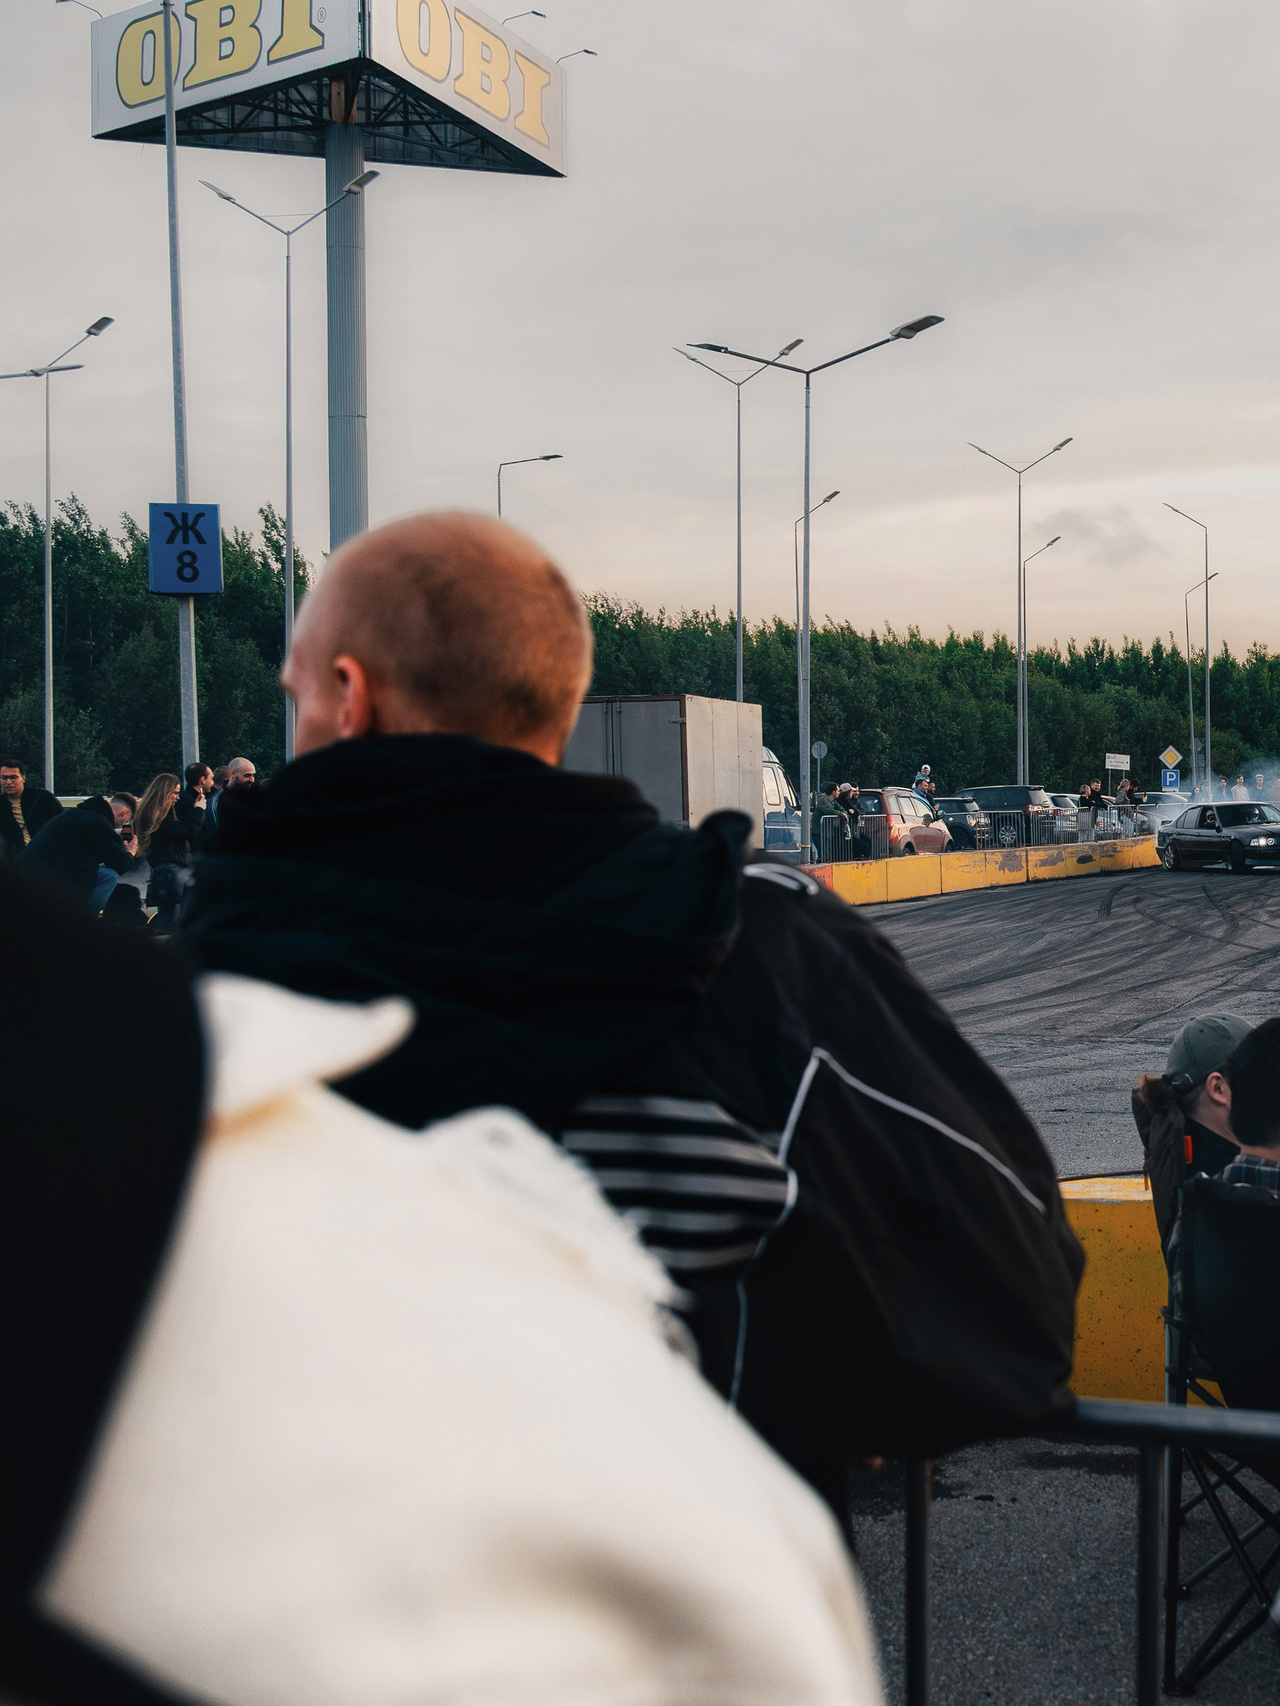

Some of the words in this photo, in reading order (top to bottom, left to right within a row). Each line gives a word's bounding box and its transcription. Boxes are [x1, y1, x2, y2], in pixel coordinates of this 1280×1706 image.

[116, 0, 325, 109] OBI
[396, 0, 551, 151] OBI
[163, 511, 207, 545] Ж
[176, 549, 200, 583] 8
[1166, 771, 1176, 785] P
